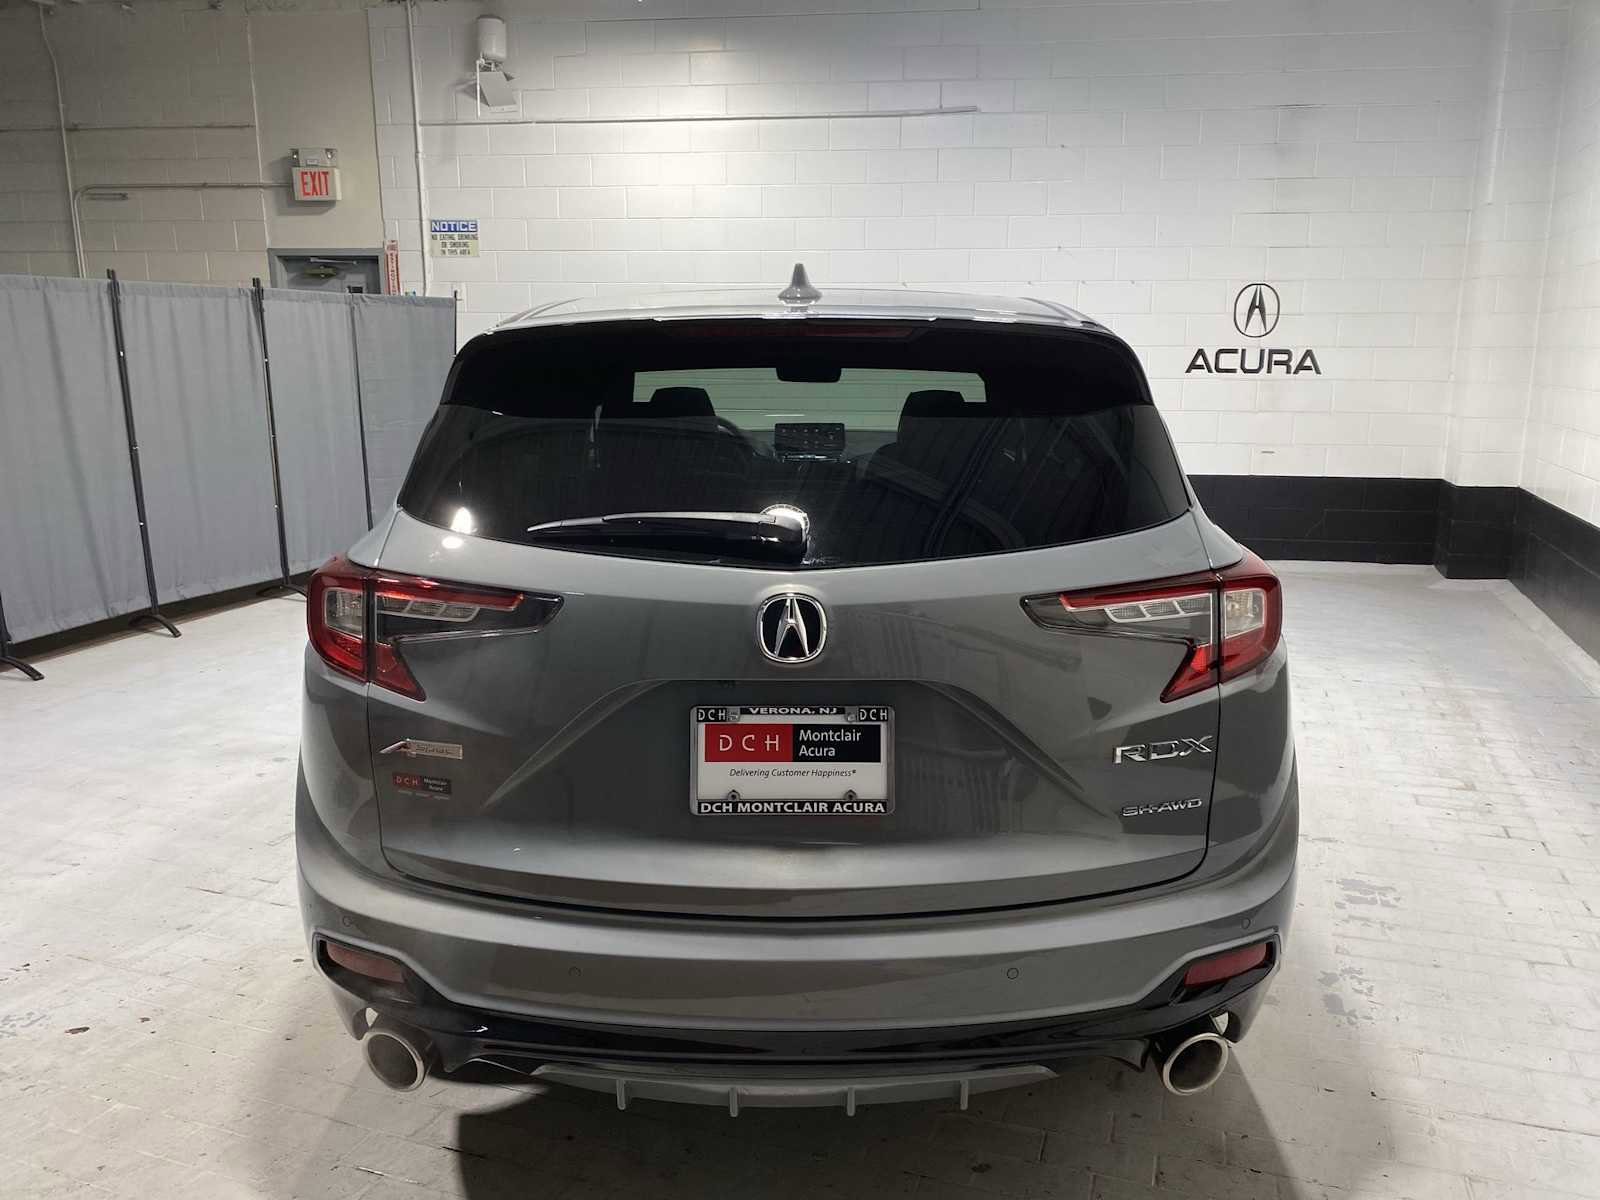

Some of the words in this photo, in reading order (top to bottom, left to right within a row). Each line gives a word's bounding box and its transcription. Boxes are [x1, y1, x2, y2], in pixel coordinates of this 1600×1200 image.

[300, 171, 329, 196] EXIT
[431, 221, 478, 231] NOTICE
[1185, 348, 1322, 375] ACURA
[698, 709, 726, 721] DCH
[819, 707, 837, 715] NJ
[859, 708, 888, 721] DCH
[799, 729, 862, 742] Montclair
[719, 734, 780, 752] DCH
[1113, 734, 1213, 764] RDX
[798, 744, 836, 757] Acura
[729, 768, 770, 779] Delivering
[771, 768, 809, 777] Customer
[700, 802, 733, 813] DCH
[737, 802, 829, 813] MONTCLAIR
[832, 802, 885, 813] ACURA
[1122, 798, 1203, 817] SH-AWD
